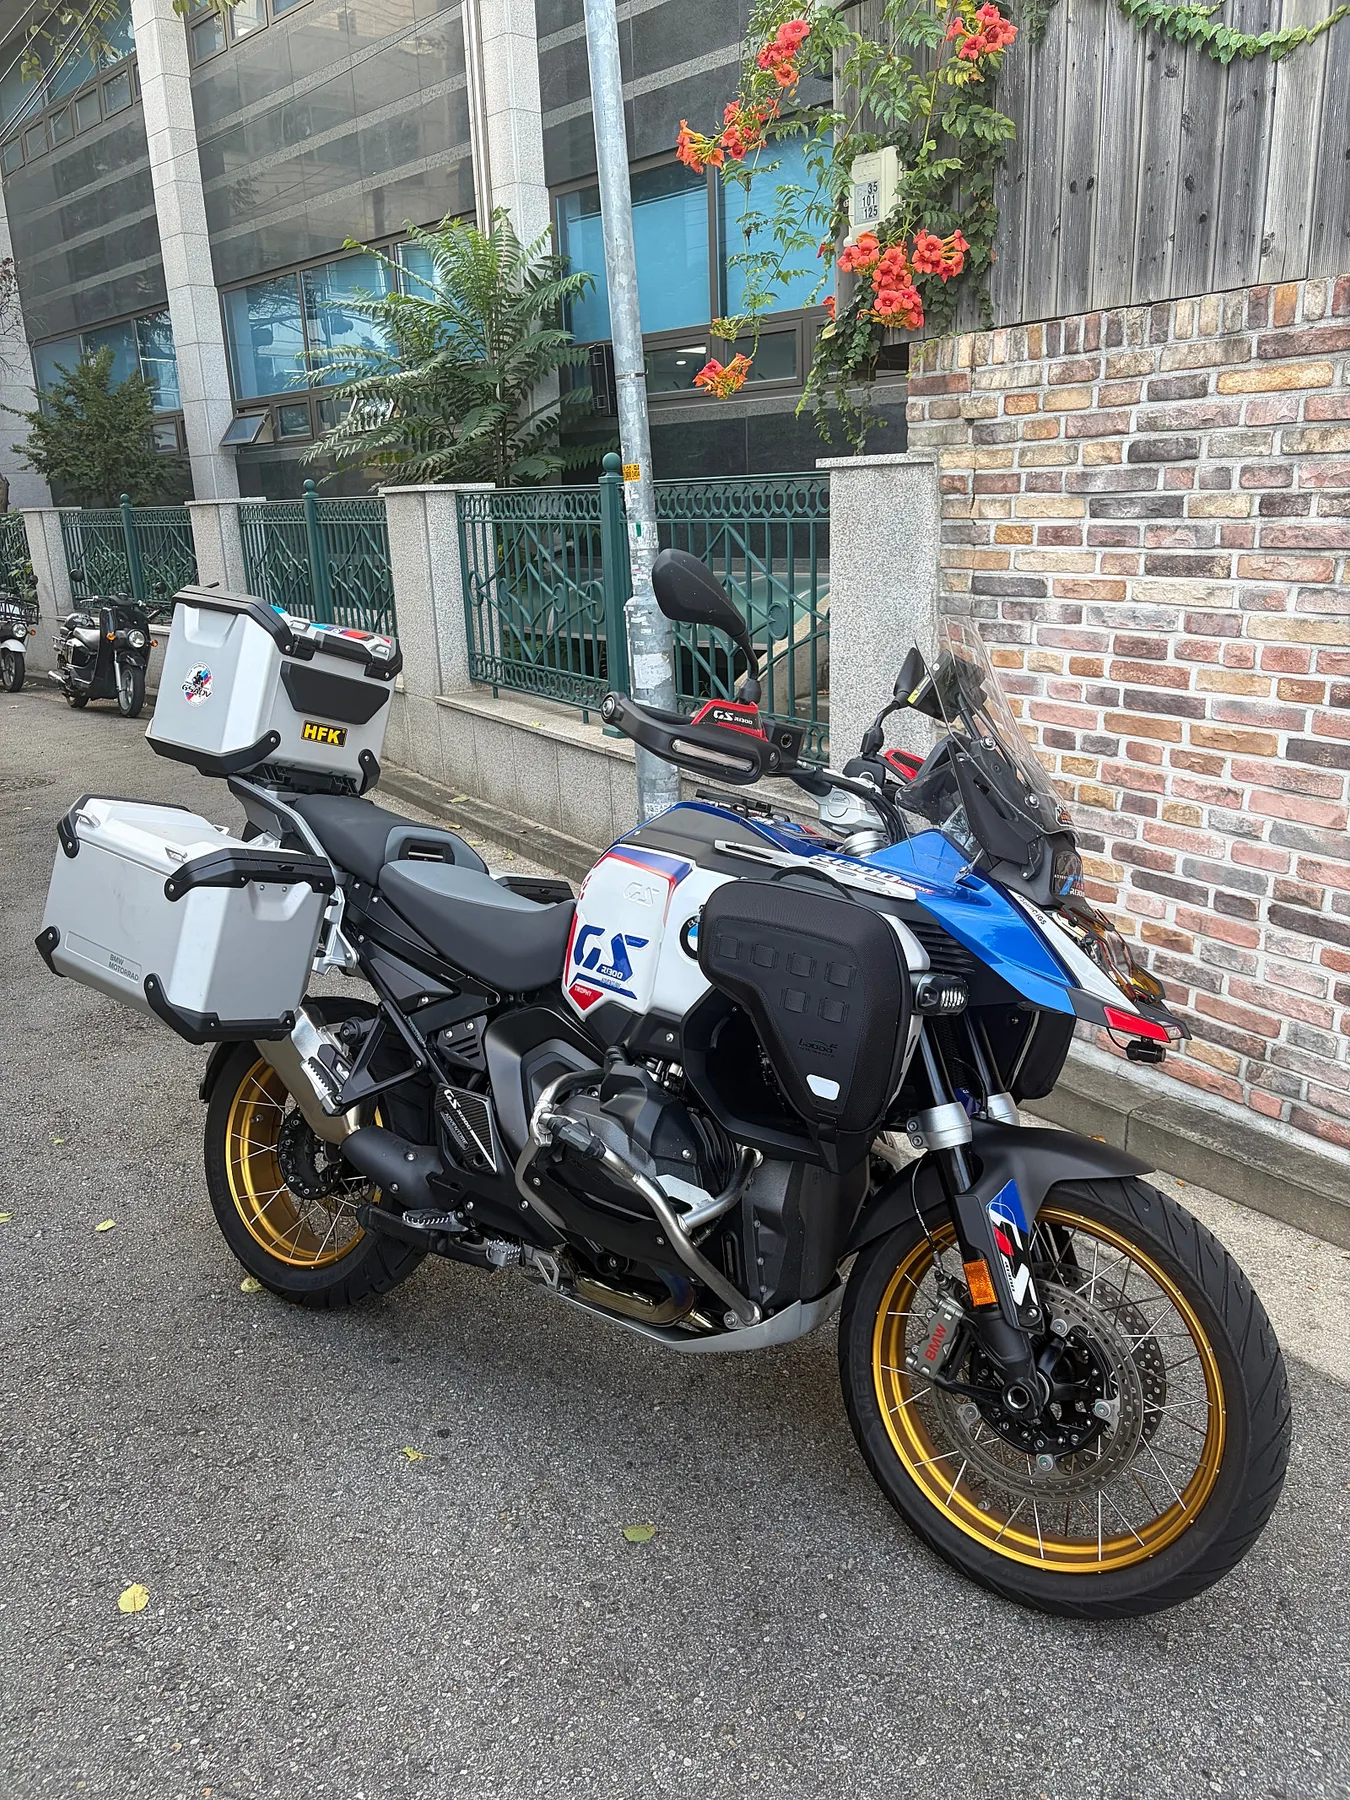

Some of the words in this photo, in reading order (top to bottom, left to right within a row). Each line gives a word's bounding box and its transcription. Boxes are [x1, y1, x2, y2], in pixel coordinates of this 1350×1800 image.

[867, 181, 878, 194] 35
[862, 194, 875, 207] 101
[864, 205, 878, 219] 125
[713, 710, 734, 721] GS
[303, 723, 341, 744] HFK
[109, 953, 125, 966] BMW
[573, 924, 650, 982] GS
[108, 961, 140, 981] MOTORRAD
[601, 965, 623, 980] R1300
[443, 1089, 462, 1110] GS
[923, 1322, 947, 1361] BMW
